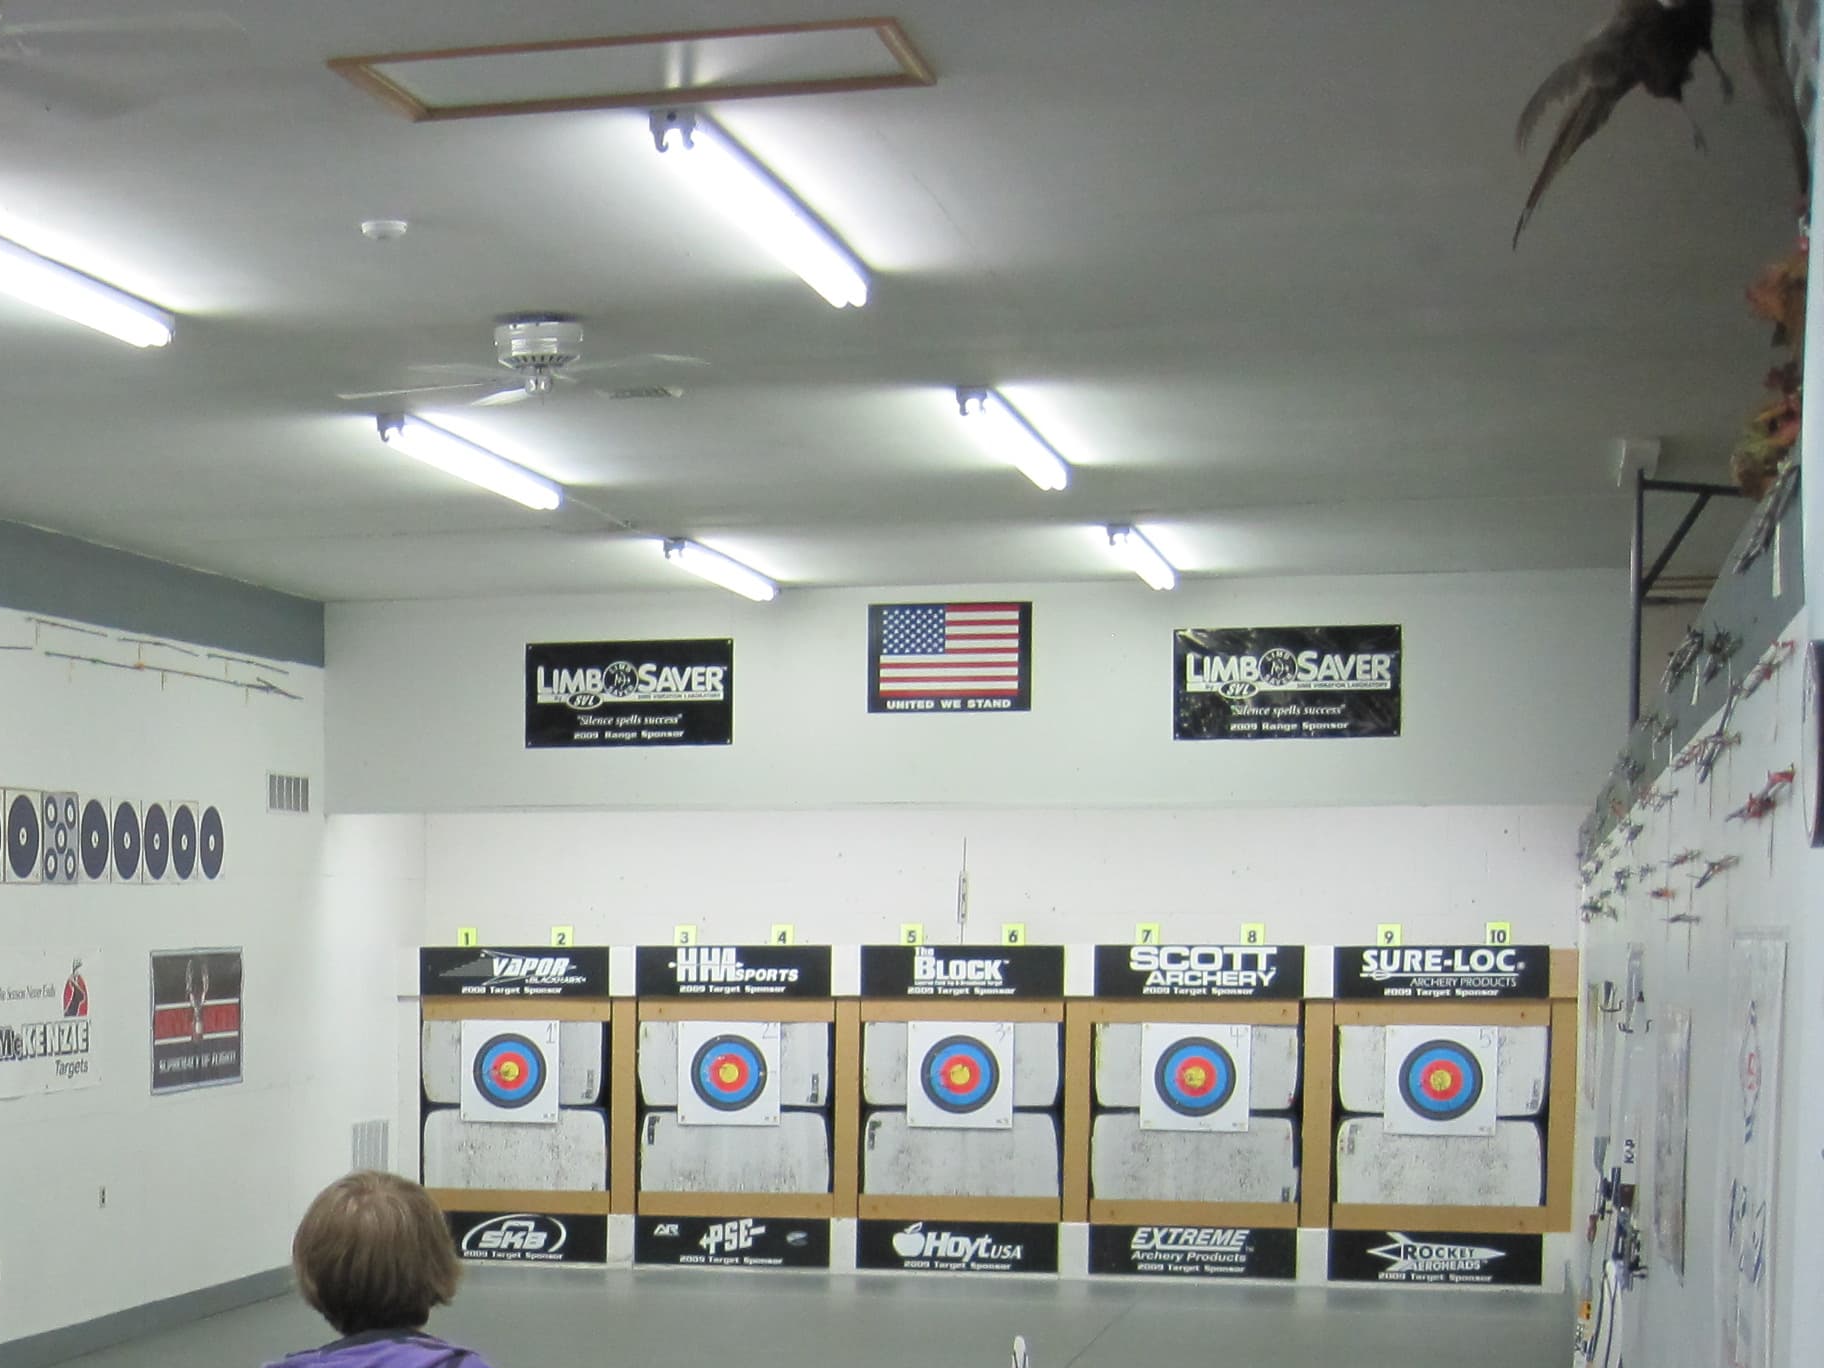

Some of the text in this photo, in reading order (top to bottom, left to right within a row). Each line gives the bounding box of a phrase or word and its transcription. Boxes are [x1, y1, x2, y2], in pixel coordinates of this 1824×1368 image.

[1186, 651, 1390, 683] LIMB SAVER
[537, 664, 724, 693] LIMB SAVER
[1227, 682, 1249, 695] SVL
[887, 699, 1011, 709] UNITED WE STAND
[1272, 704, 1300, 717] spells
[615, 714, 641, 728] spells
[1230, 721, 1349, 731] 2009 Range Sponsor
[605, 731, 637, 740] Range
[641, 730, 684, 740] Sponsor
[464, 932, 470, 945] 1
[558, 932, 566, 945] 2
[680, 931, 689, 944] 3
[778, 931, 787, 944] 4
[907, 930, 916, 943] 5
[1008, 930, 1018, 943] 6
[1142, 929, 1152, 943] 7
[1247, 930, 1257, 943] 8
[1384, 930, 1394, 943] 9
[1491, 929, 1506, 943] 10
[914, 947, 934, 956] The
[677, 948, 799, 982] HHA SPORTS
[1129, 946, 1277, 971] SCOTT
[1362, 949, 1516, 971] SURE-LOC
[493, 957, 570, 976] VAPOR
[914, 956, 1003, 980] BLOCK
[1145, 970, 1276, 987] ARCHERY
[1410, 976, 1517, 987] ARCHERY PRODUCTS
[490, 986, 520, 995] Target
[524, 986, 563, 995] Sponsor
[709, 985, 740, 994] Target
[745, 985, 786, 994] Sponsor
[938, 987, 969, 996] Target
[974, 987, 1016, 995] Sponsor
[1174, 987, 1206, 995] Target
[1212, 987, 1254, 995] Sponsor
[1416, 988, 1450, 997] Target
[1456, 988, 1499, 997] Sponsor
[55, 1058, 88, 1079] Targets
[479, 1229, 547, 1250] SKB
[706, 1218, 755, 1255] PSE
[1131, 1227, 1250, 1251] EXTREME
[923, 1231, 1022, 1262] Hoyt USA
[1402, 1244, 1476, 1261] ROCKET
[492, 1251, 521, 1259] Target
[526, 1252, 564, 1260] Sponsor
[708, 1256, 739, 1264] Target
[744, 1257, 784, 1265] Sponsor
[1131, 1250, 1247, 1262] Archery Products
[935, 1261, 966, 1270] Target
[971, 1262, 1012, 1270] Sponsor
[1168, 1264, 1200, 1272] Target
[1204, 1265, 1246, 1273] Sponsor
[1411, 1260, 1480, 1271] AEROHEADS
[1411, 1273, 1444, 1282] Target
[1449, 1274, 1493, 1283] Sponsor
